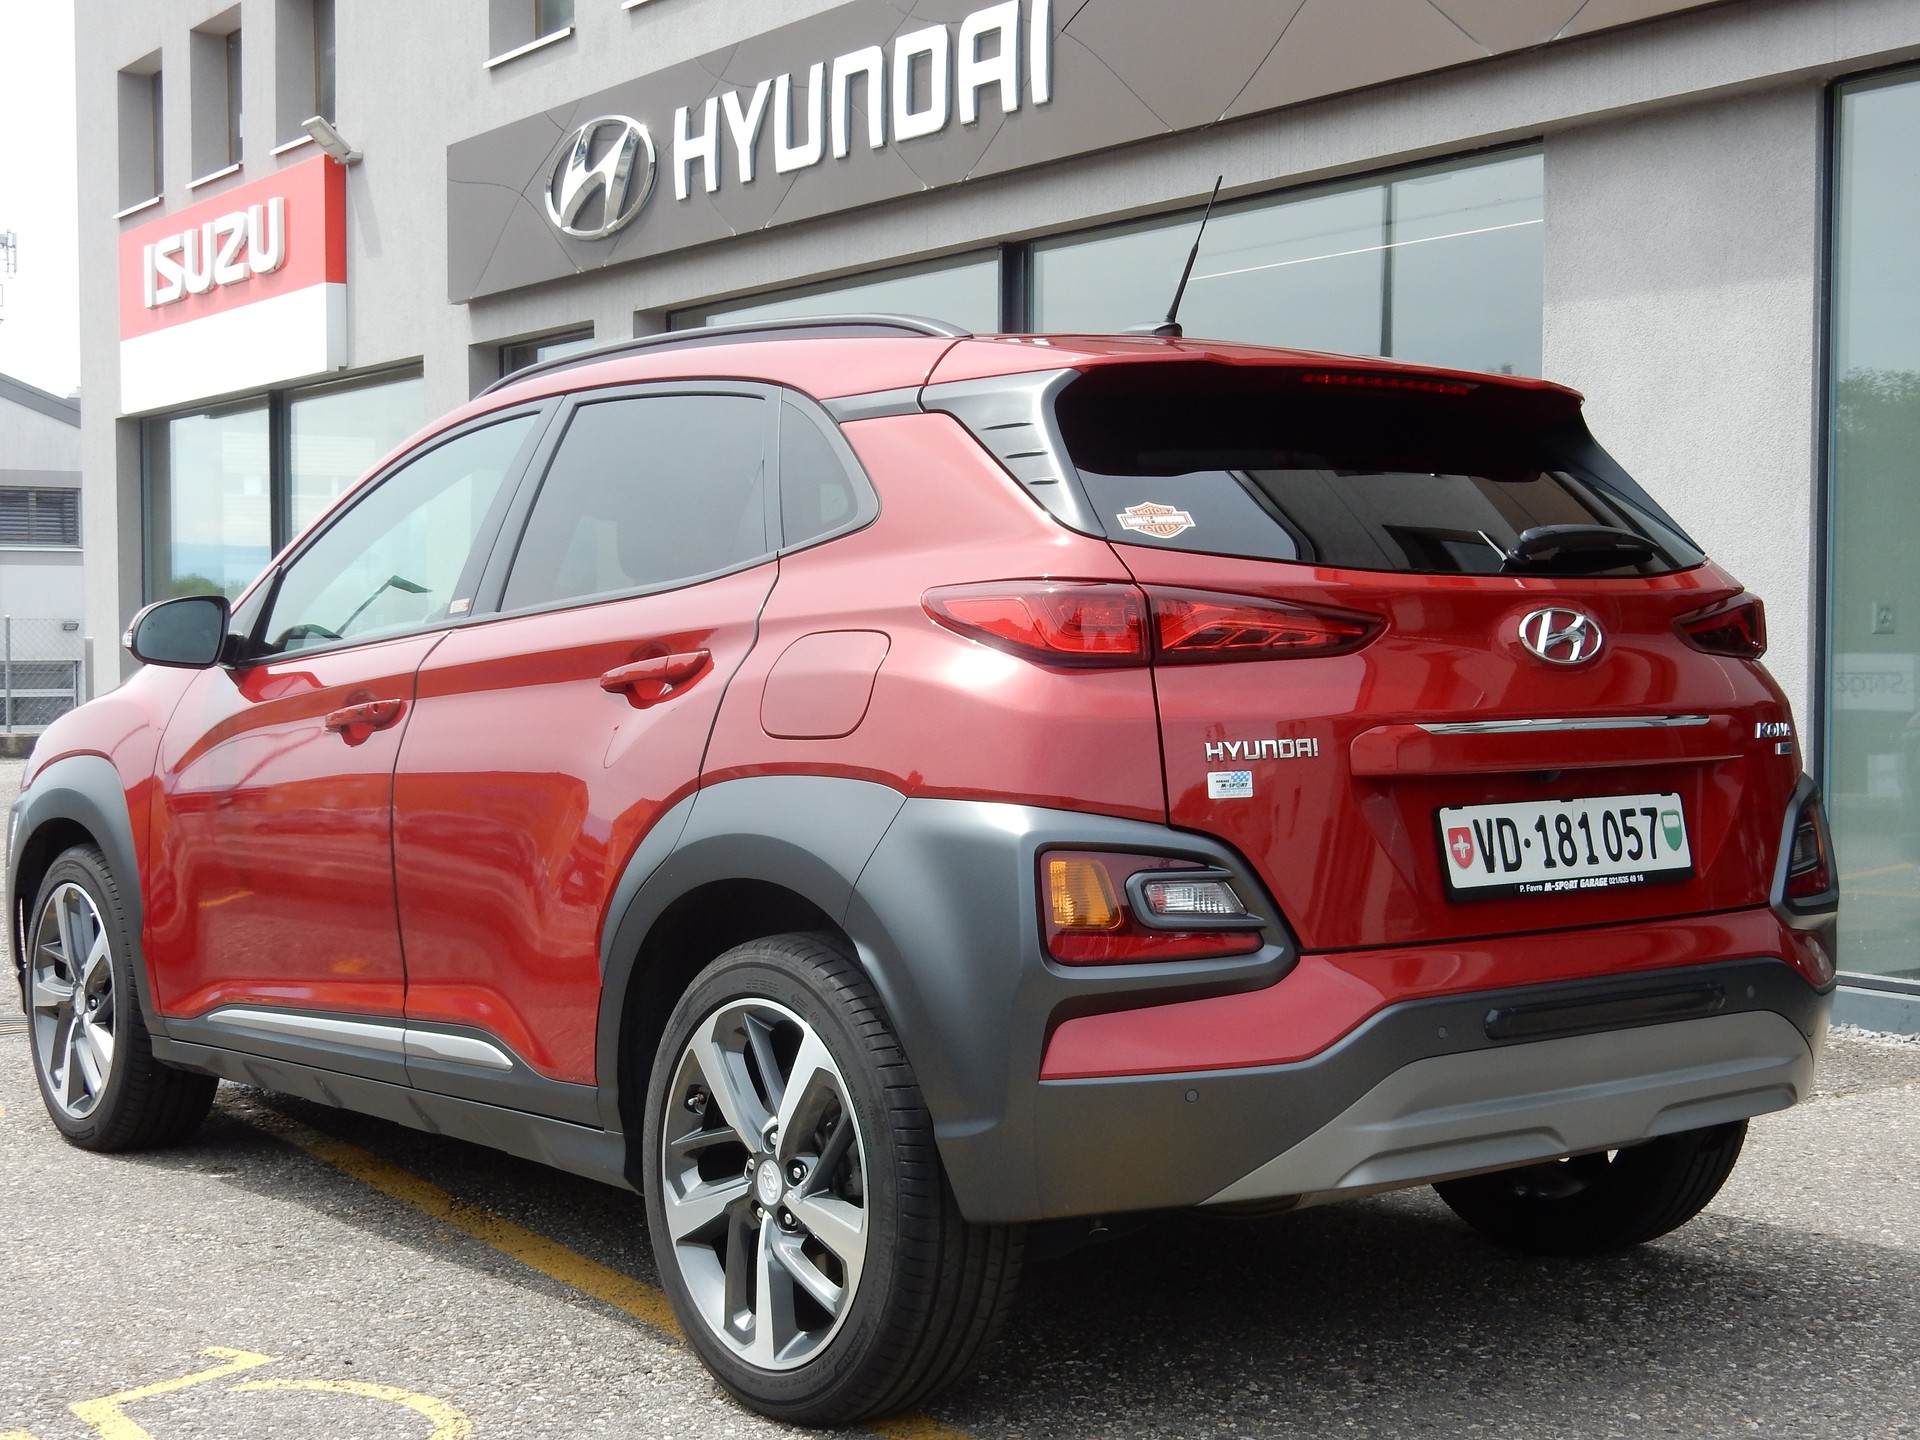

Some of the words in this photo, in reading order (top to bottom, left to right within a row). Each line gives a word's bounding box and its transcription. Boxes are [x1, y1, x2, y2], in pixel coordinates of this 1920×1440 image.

[673, 0, 1050, 200] HYUNDAI
[144, 197, 285, 309] ISUZU
[1205, 738, 1319, 761] HYUNDAI
[1580, 877, 1608, 888] GARAGE
